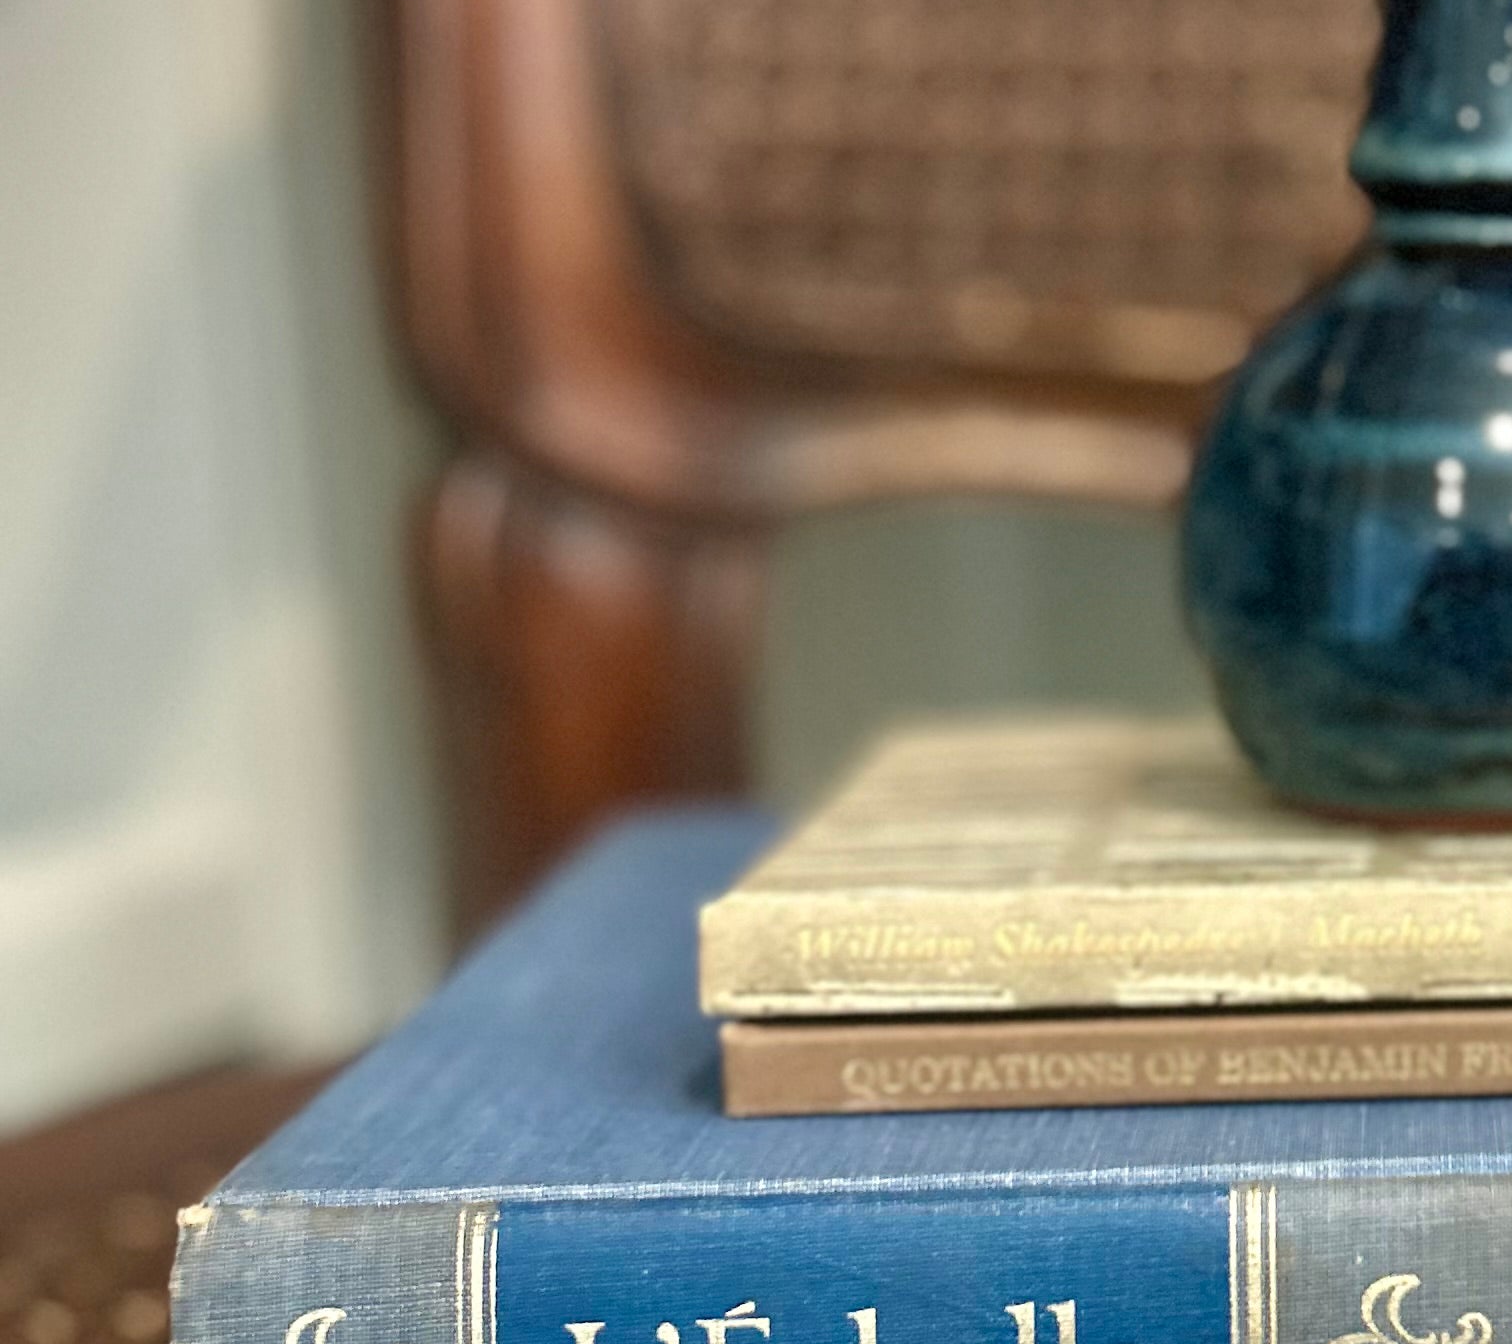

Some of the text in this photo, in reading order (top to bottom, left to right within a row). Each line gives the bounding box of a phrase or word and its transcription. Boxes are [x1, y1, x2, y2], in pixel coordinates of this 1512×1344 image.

[841, 1050, 1135, 1099] QUOTATIONS
[1145, 1049, 1206, 1087] OF
[1215, 1041, 1449, 1086] BENJAMIN
